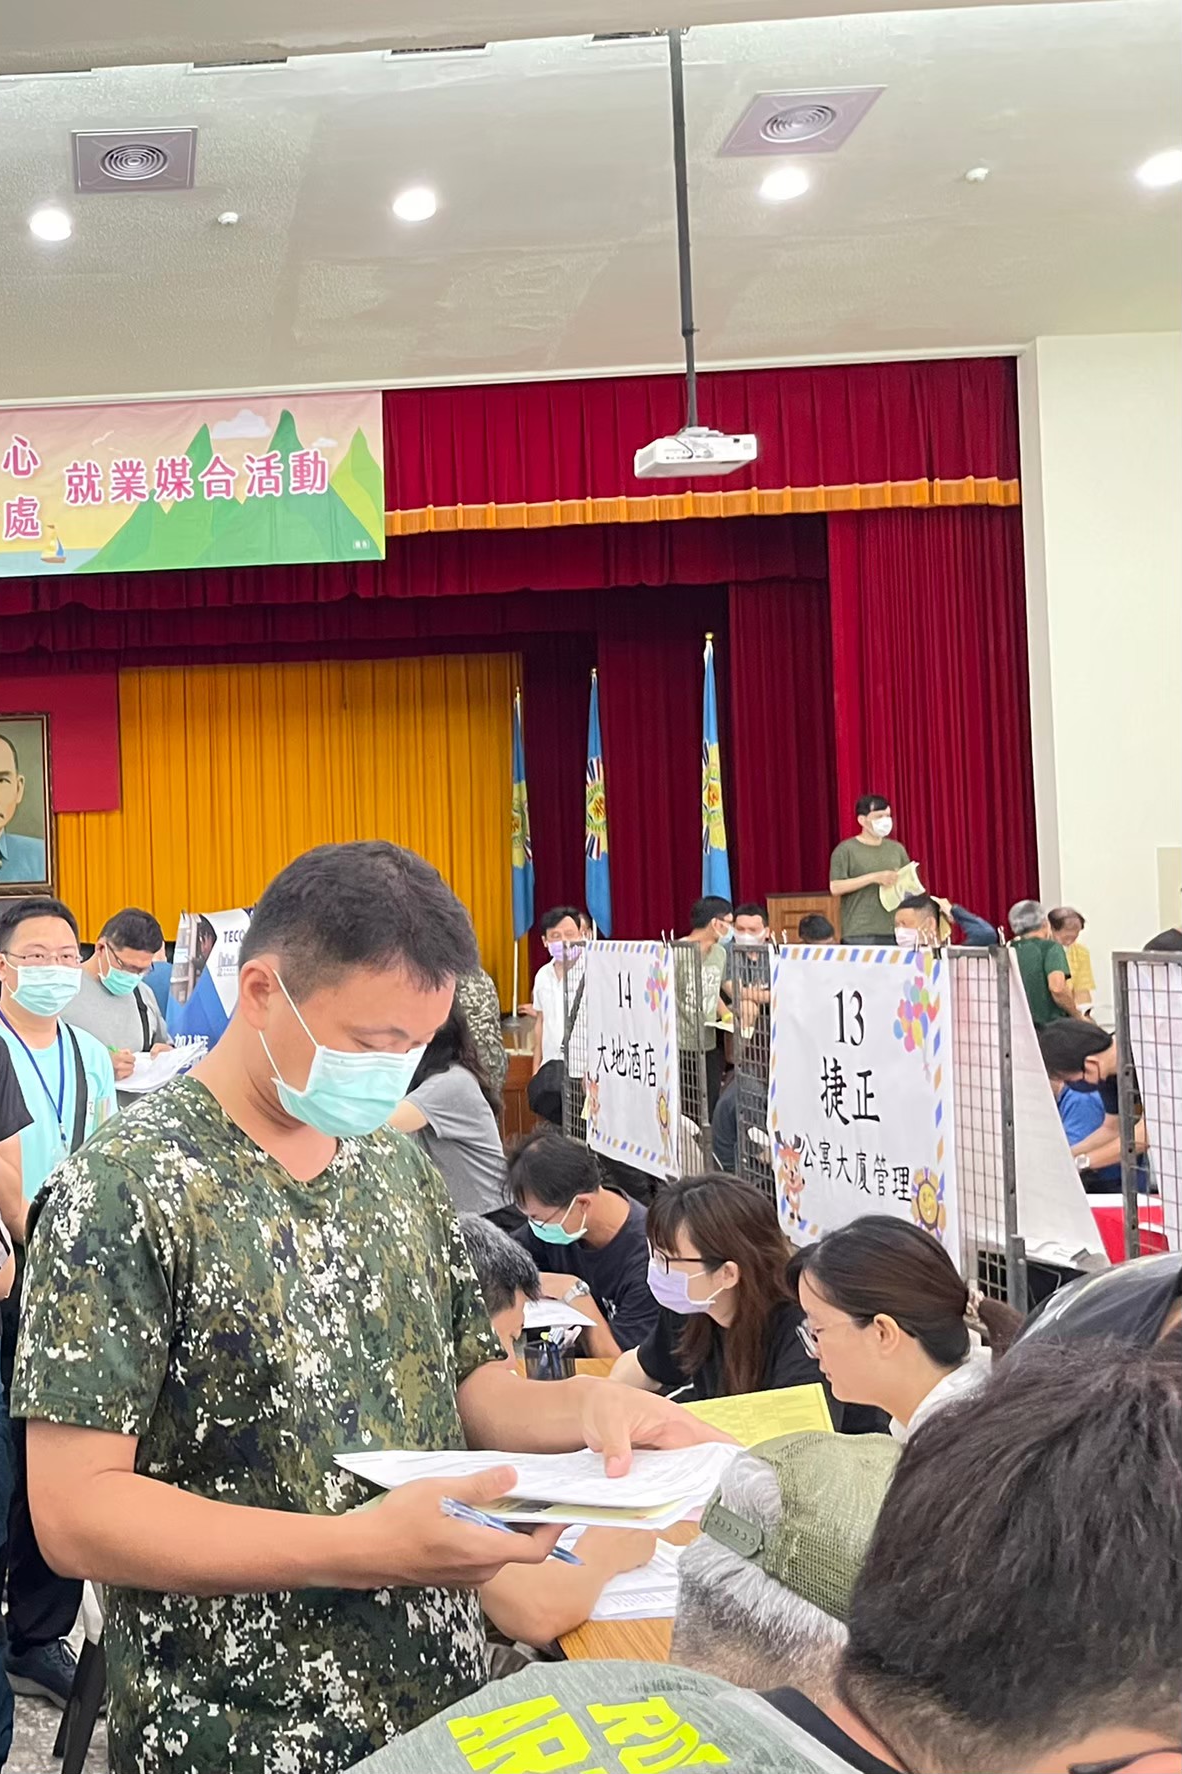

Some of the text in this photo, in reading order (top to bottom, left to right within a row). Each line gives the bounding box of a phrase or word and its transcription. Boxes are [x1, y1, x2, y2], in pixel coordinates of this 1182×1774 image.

[65, 450, 328, 504] 就業媒合活動
[618, 971, 633, 1009] 14
[833, 989, 865, 1046] 13
[597, 1032, 657, 1087] 大地酒店
[820, 1056, 880, 1125] 捷正
[800, 1133, 912, 1202] 公寓大廈管理
